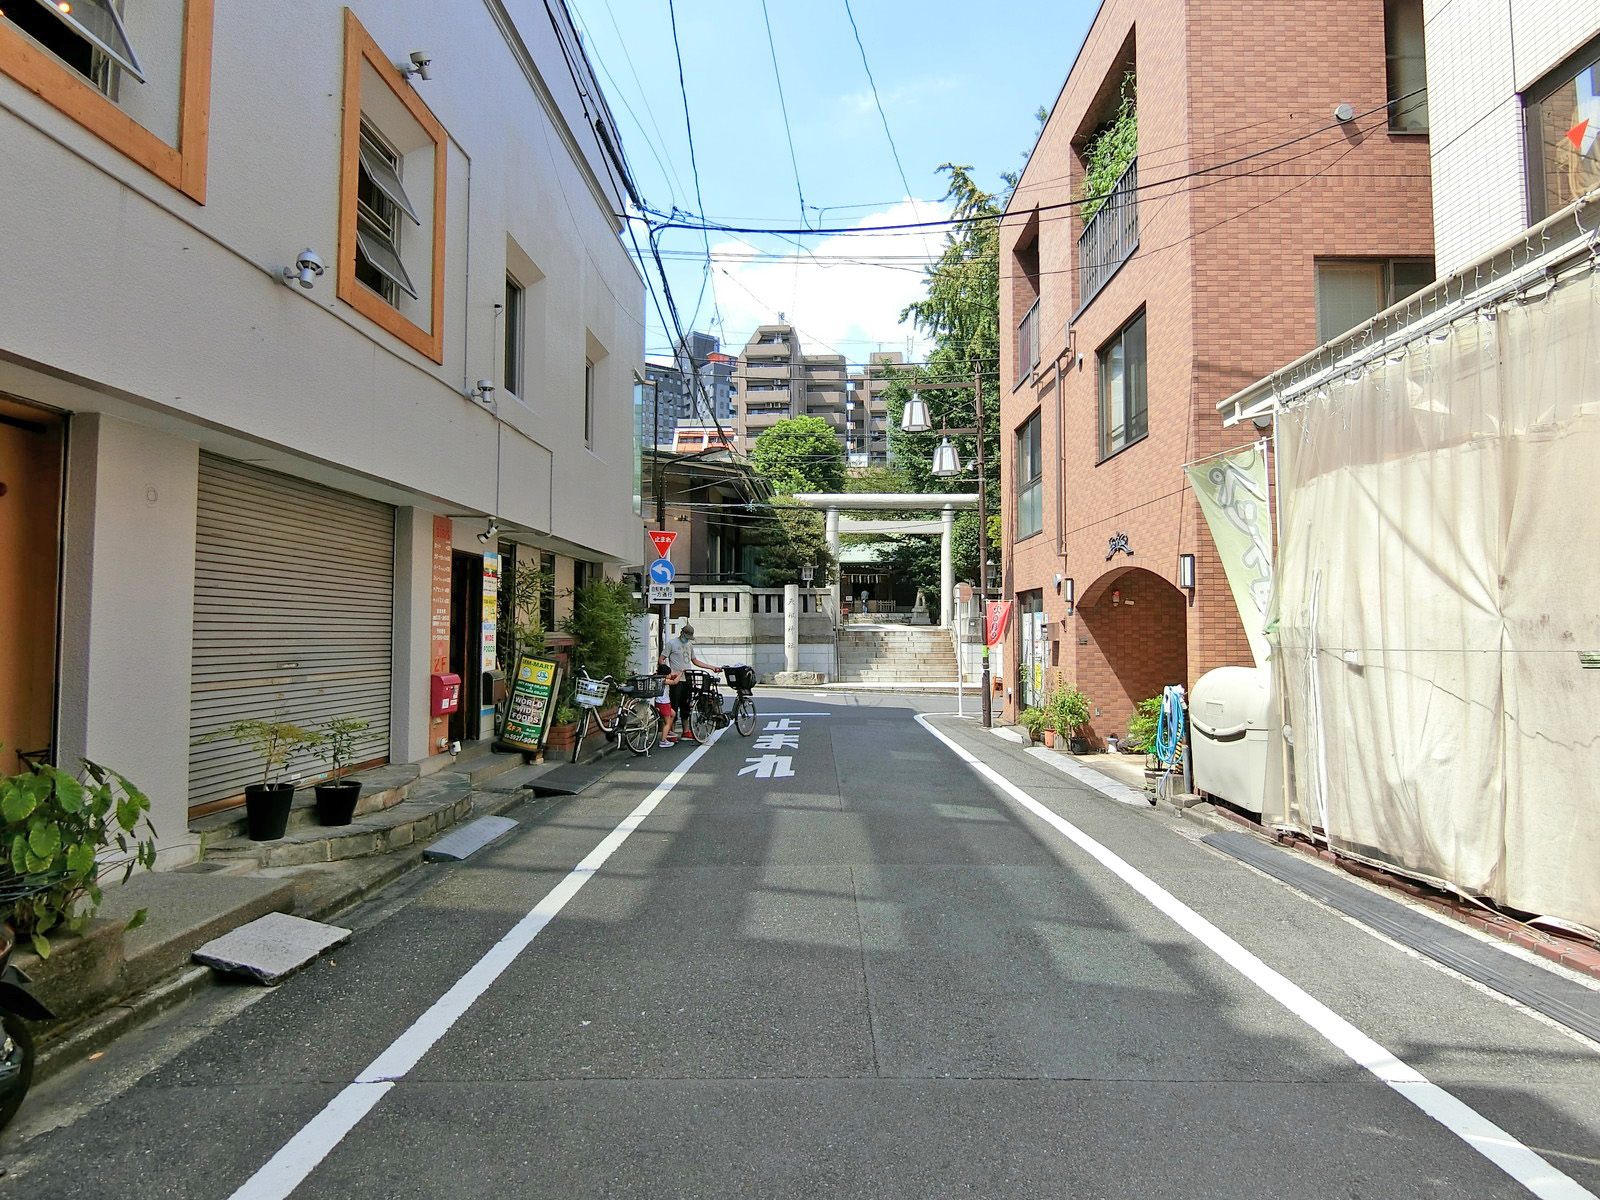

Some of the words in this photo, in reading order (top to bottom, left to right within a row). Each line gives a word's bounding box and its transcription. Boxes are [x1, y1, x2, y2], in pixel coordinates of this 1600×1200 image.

[654, 535, 672, 543] 止まれ
[434, 656, 447, 673] 2F
[515, 696, 543, 708] WORLD
[516, 705, 536, 717] WIDE
[512, 712, 539, 723] FOODS
[737, 718, 802, 778] 止まれ
